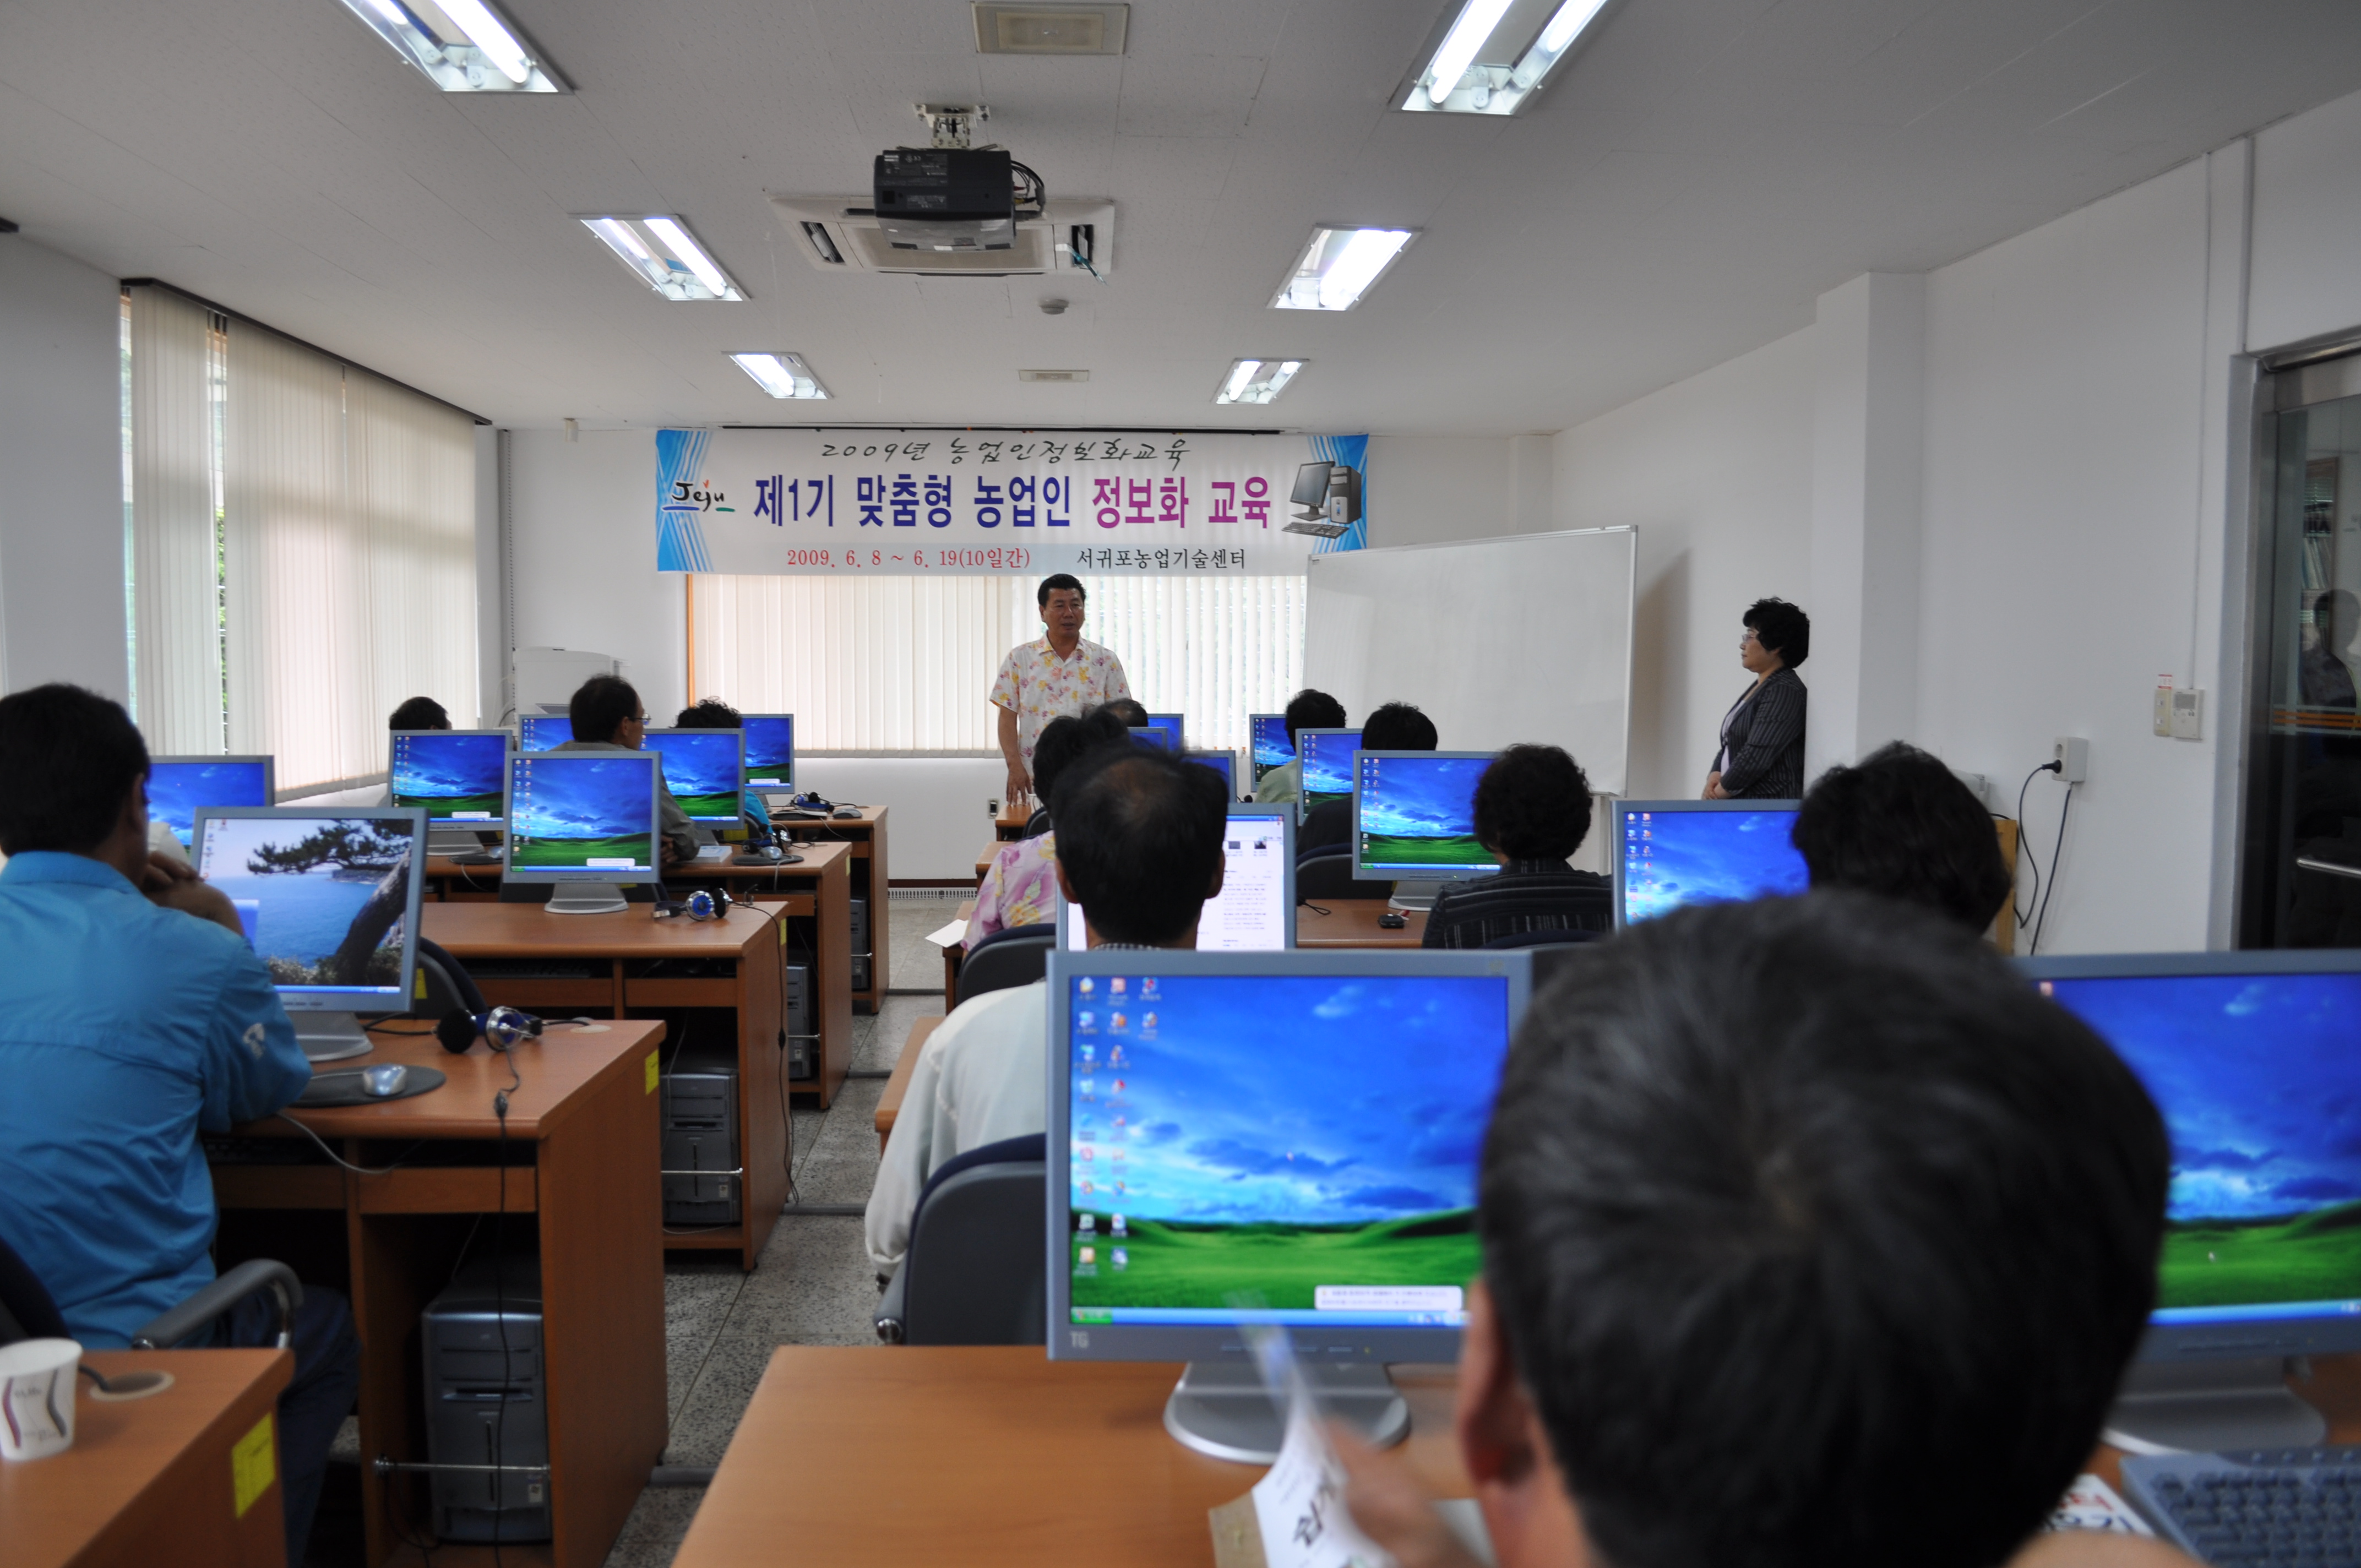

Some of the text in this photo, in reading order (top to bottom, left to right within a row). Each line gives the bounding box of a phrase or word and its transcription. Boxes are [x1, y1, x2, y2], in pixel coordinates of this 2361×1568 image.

[821, 441, 931, 462] 2009년
[671, 480, 725, 512] Jeju
[753, 473, 1271, 529] 제1기 맞춤형 농업인 정보화 교육
[787, 549, 835, 568] 2009.
[846, 549, 861, 568] 6.
[872, 549, 881, 565] 8
[913, 549, 929, 568] 6.
[940, 548, 1030, 568] 19(10일간)
[1077, 548, 1245, 569] 서귀포농업기술센터
